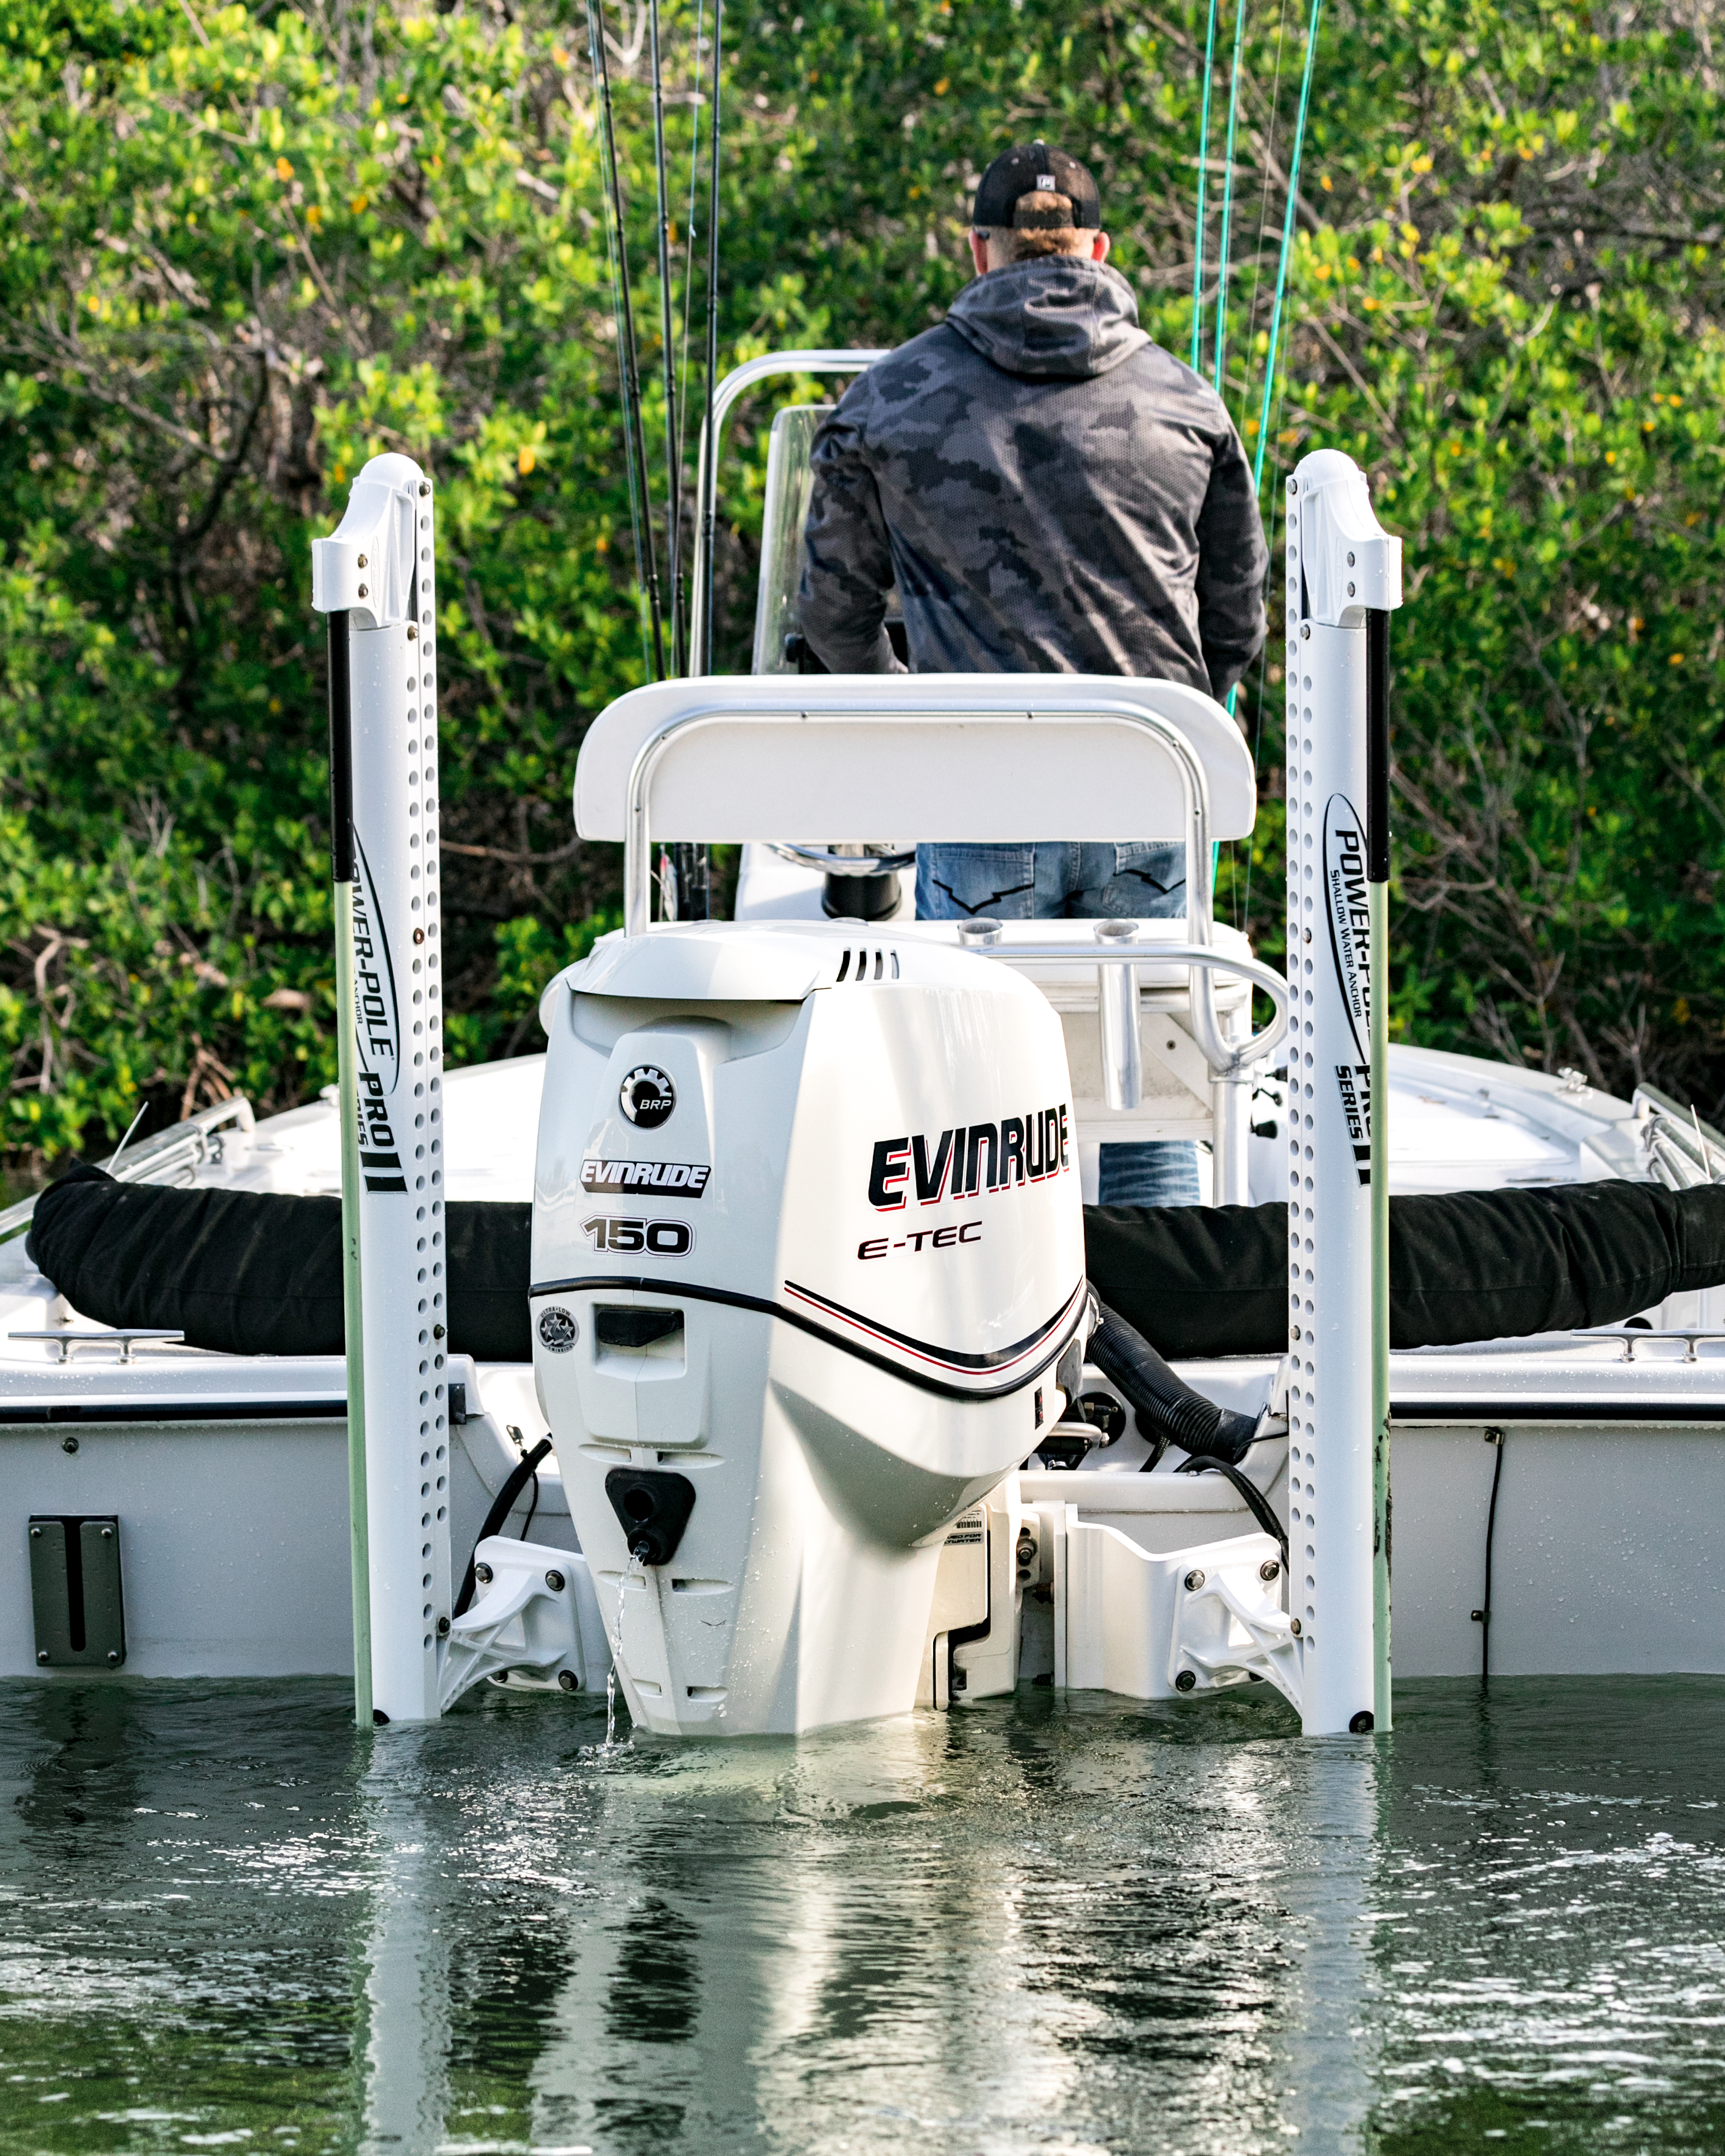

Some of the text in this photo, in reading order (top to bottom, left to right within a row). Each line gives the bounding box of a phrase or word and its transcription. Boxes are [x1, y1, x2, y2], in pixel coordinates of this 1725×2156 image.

[1331, 870, 1362, 1018] SHALLOW WATER ANCHOR
[1336, 830, 1370, 1046] POWER-
[358, 1072, 394, 1147] PRO
[639, 1099, 672, 1110] BRP
[1336, 1065, 1364, 1139] SERIES
[580, 1161, 709, 1189] EVINRUDE
[868, 1103, 1069, 1211] EVINRUDE
[580, 1215, 692, 1257] 150
[857, 1221, 982, 1260] E-TEC
